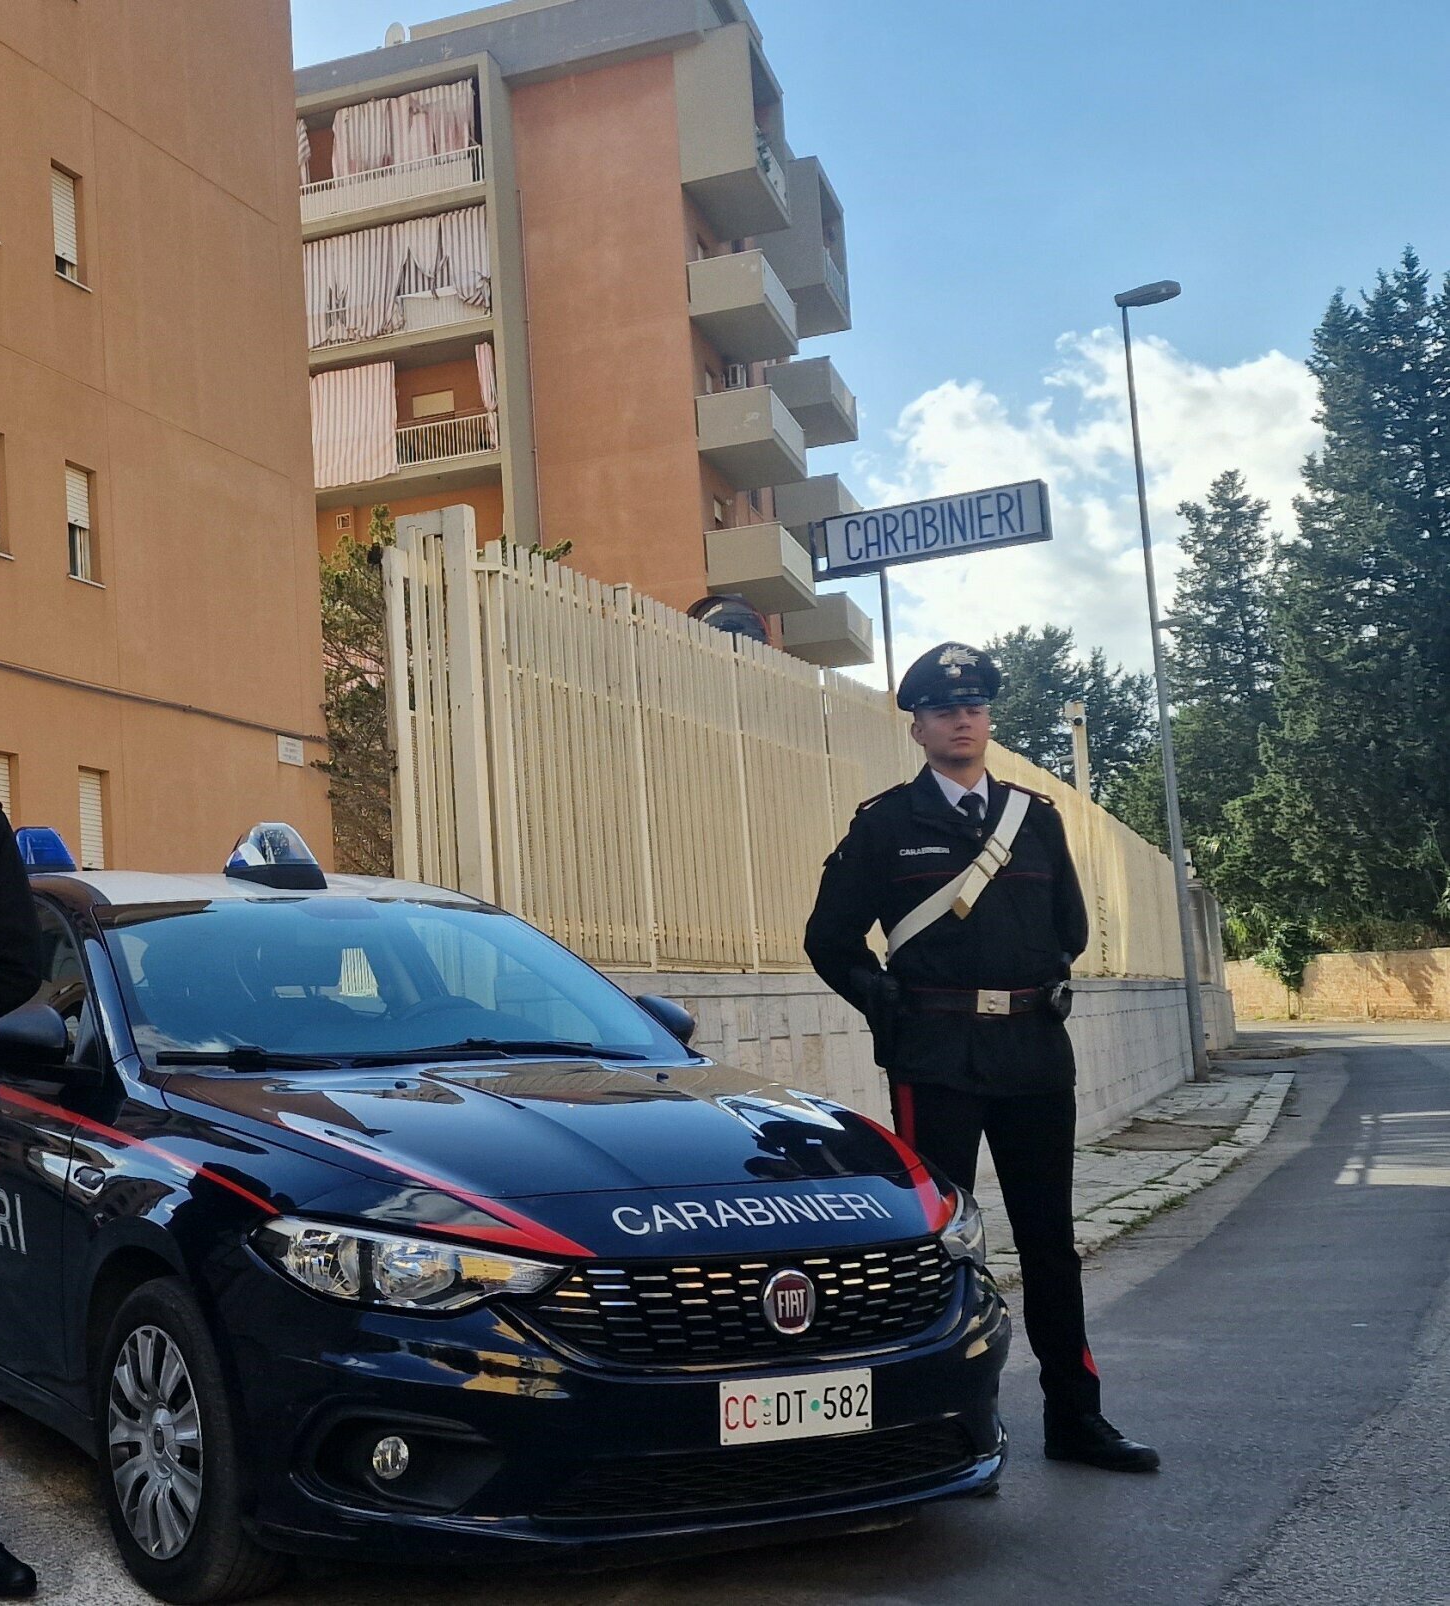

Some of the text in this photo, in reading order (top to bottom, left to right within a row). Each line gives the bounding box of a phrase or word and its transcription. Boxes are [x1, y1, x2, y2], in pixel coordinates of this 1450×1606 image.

[845, 489, 1025, 561] CARABINIERI
[612, 1193, 892, 1236] CARABINIERI
[776, 1289, 806, 1319] FIAT
[725, 1384, 869, 1430] CC DT 582
